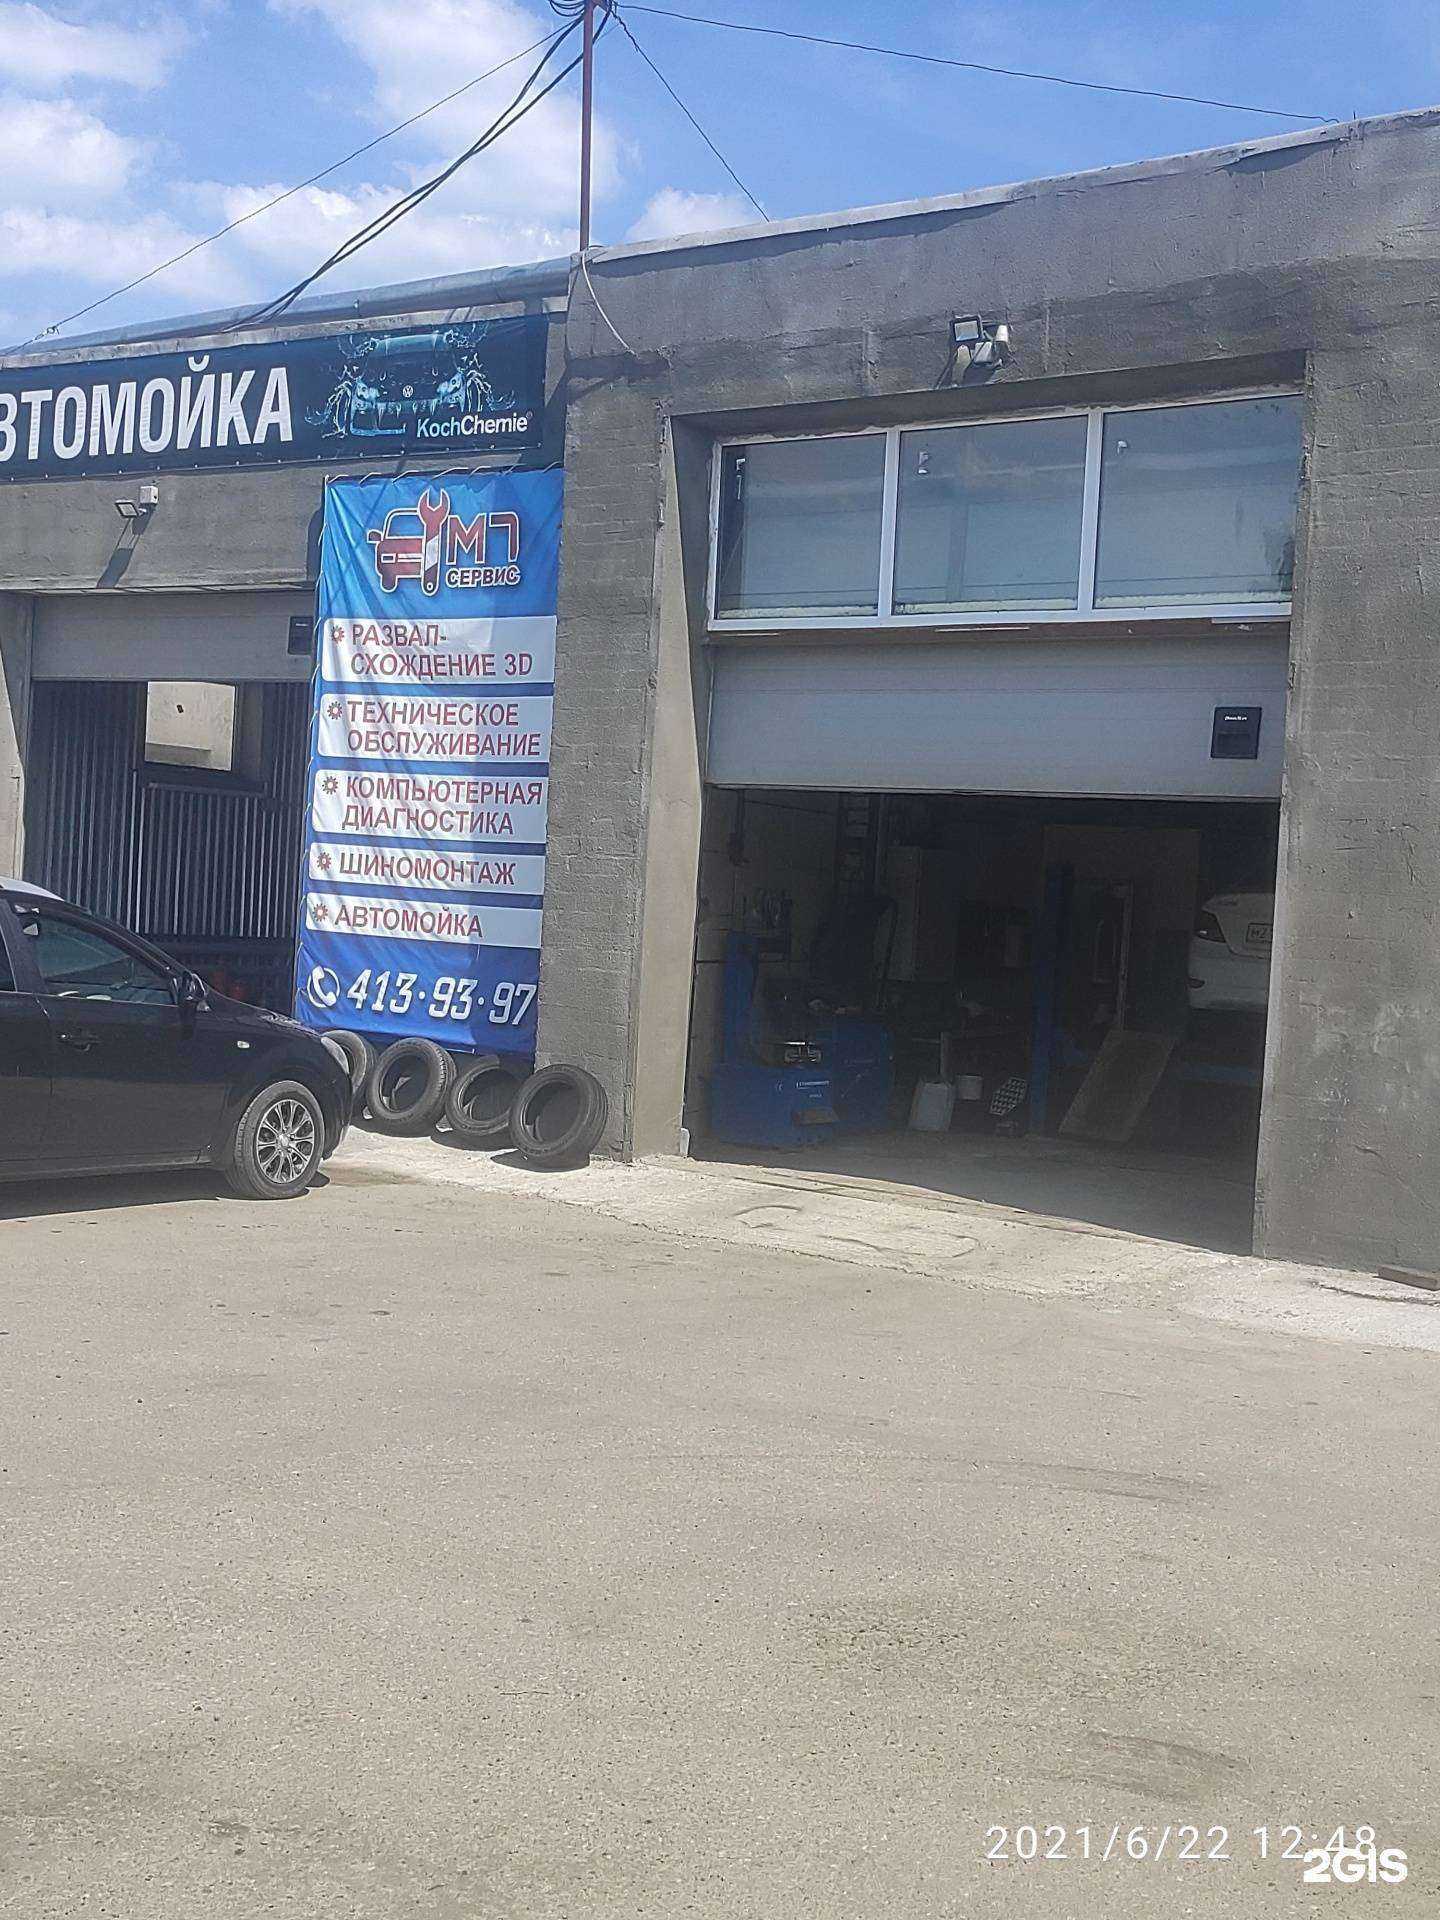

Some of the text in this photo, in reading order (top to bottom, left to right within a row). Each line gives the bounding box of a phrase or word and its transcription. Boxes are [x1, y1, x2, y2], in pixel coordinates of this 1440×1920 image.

[416, 412, 529, 439] KochChemie
[445, 564, 521, 588] СЕРВИС
[351, 623, 447, 648] РАЗВАЛ-
[351, 652, 533, 680] СХОЖДЕНИЕ 3D
[347, 700, 519, 726] ТЕХНИЧЕСКОЕ
[347, 729, 541, 756] ОБСЛУЖИВАНИЕ
[346, 776, 543, 805] КОМПЬЮТЕРНАЯ
[341, 804, 514, 836] ДИАГНОСТИКА
[339, 852, 516, 885] ШИНОМОНТАЖ
[334, 904, 483, 938] АВТОМОЙКА
